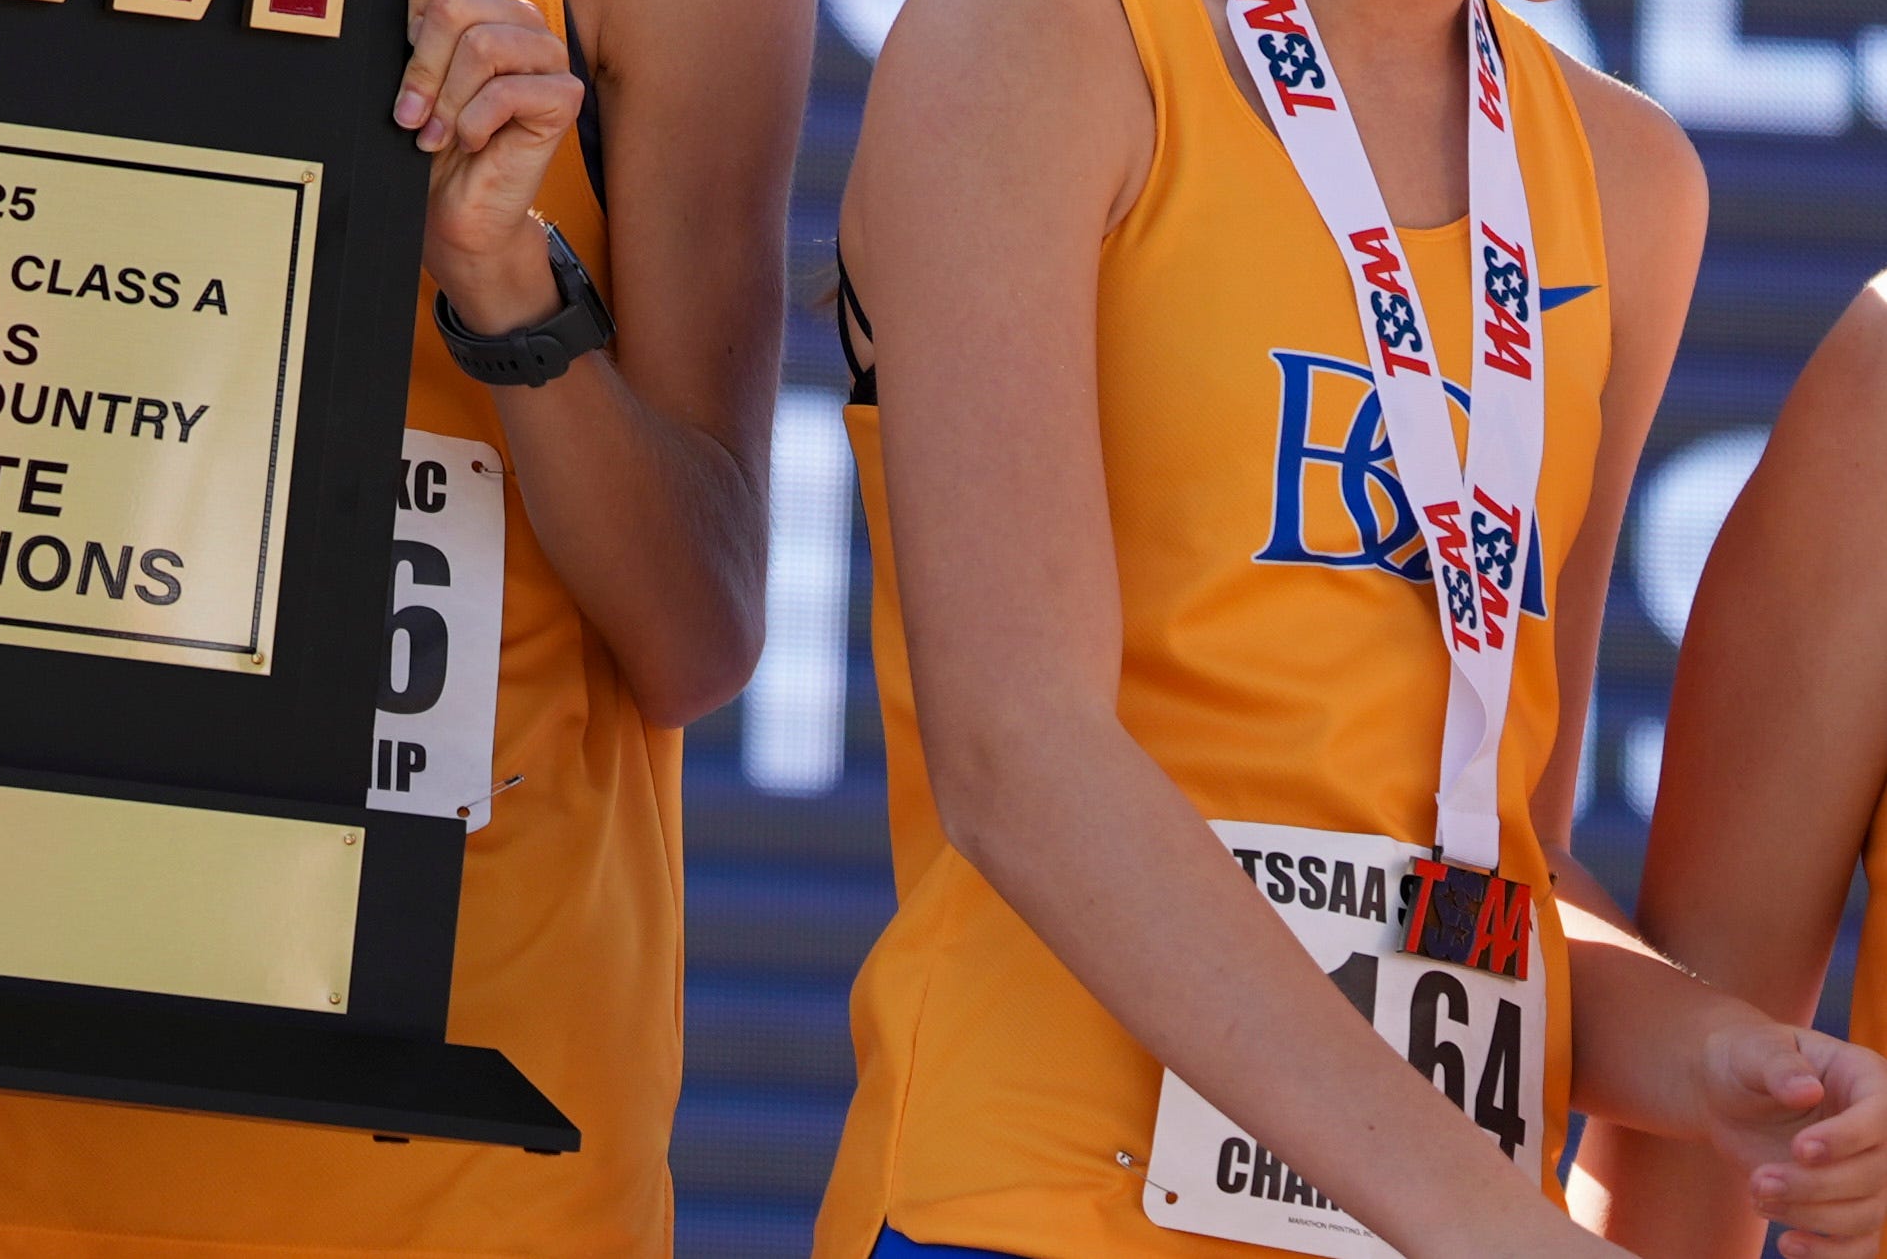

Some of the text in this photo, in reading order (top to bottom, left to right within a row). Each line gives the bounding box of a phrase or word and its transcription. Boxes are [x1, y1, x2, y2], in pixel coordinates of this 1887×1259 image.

[11, 255, 182, 309] CLASS
[194, 279, 230, 316] A
[1348, 227, 1431, 377] TSSAA
[1481, 221, 1532, 380] TSSAA
[1423, 500, 1480, 653] TSSAA
[1471, 485, 1521, 650] TSSAA
